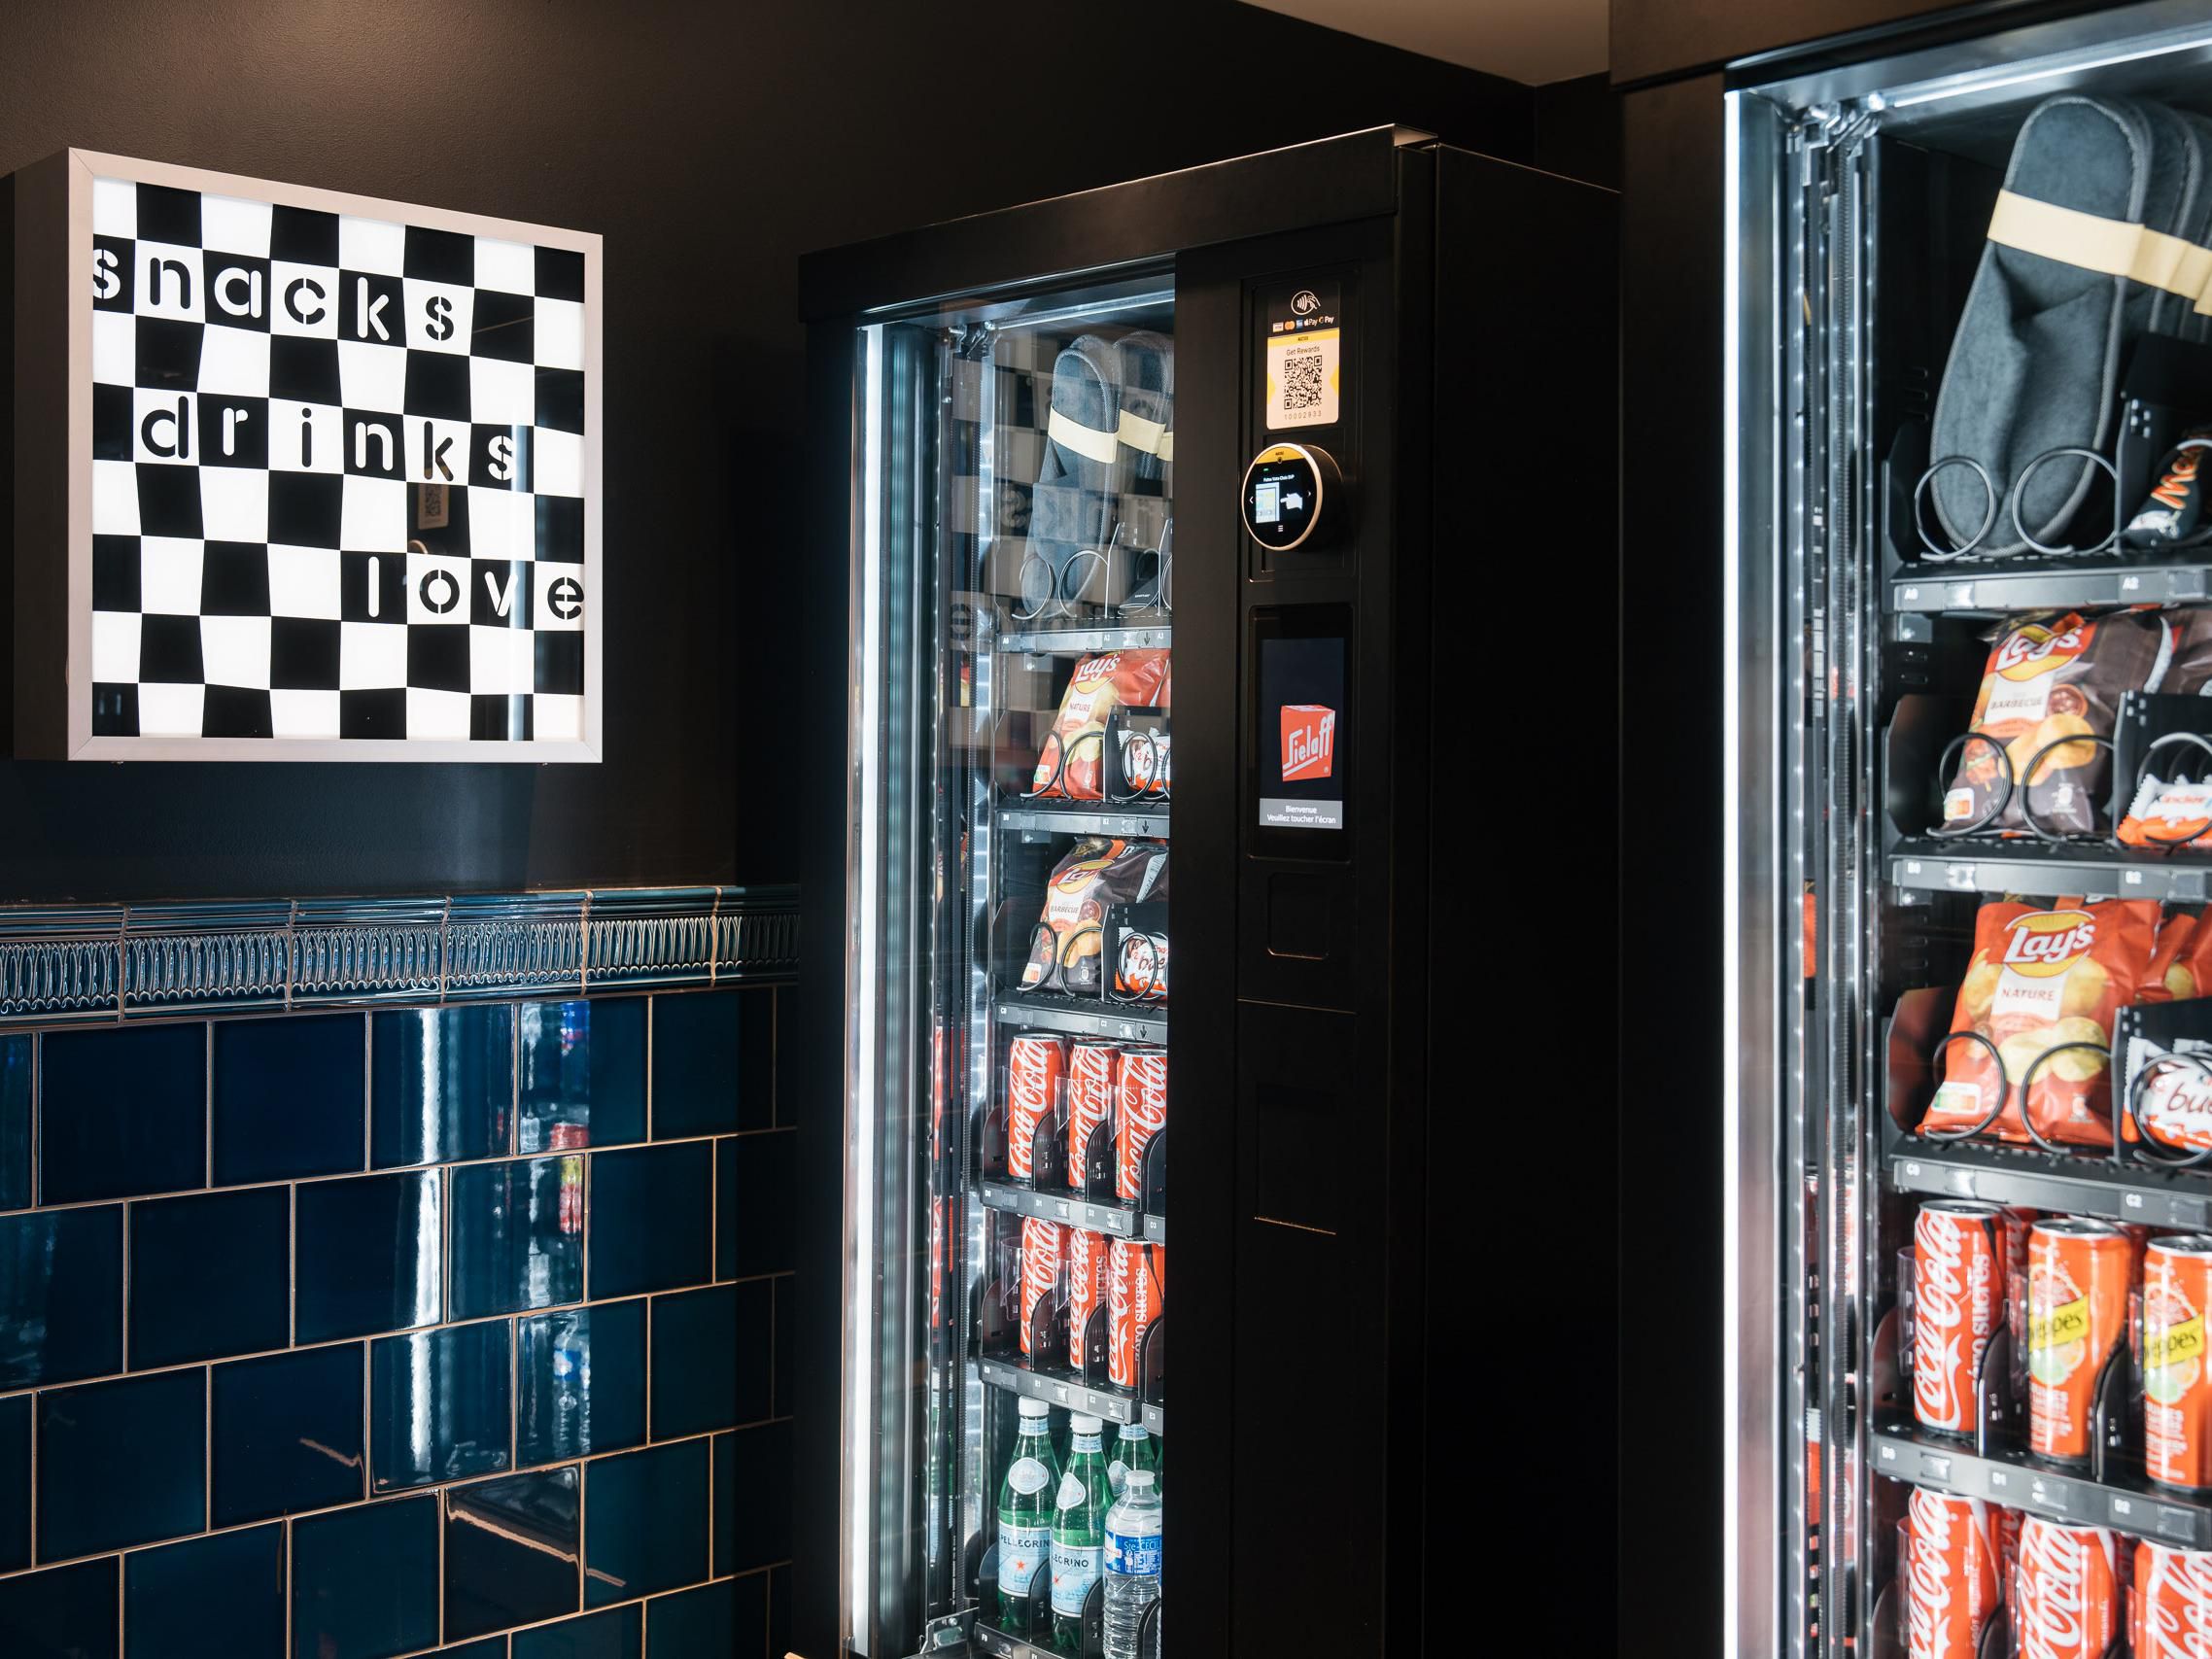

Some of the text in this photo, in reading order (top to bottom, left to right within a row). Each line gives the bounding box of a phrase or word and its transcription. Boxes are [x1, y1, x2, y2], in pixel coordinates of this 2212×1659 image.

[92, 248, 455, 342] snacks
[1296, 345, 1321, 355] Rewards
[140, 395, 518, 483] drinks
[367, 555, 585, 621] love
[1075, 654, 1122, 683] Lay's
[1068, 700, 1091, 714] NATURE
[1282, 712, 1334, 771] Sielaff
[1266, 813, 1336, 825] Veuillez toucher l'écran
[1285, 805, 1318, 814] Bienvenue
[2003, 921, 2097, 964] Lay's
[2001, 985, 2056, 1002] NATURE
[1135, 1267, 1148, 1323] sucres
[1971, 1254, 1990, 1338] sucres
[1001, 1533, 1050, 1548] PELLEGRIN
